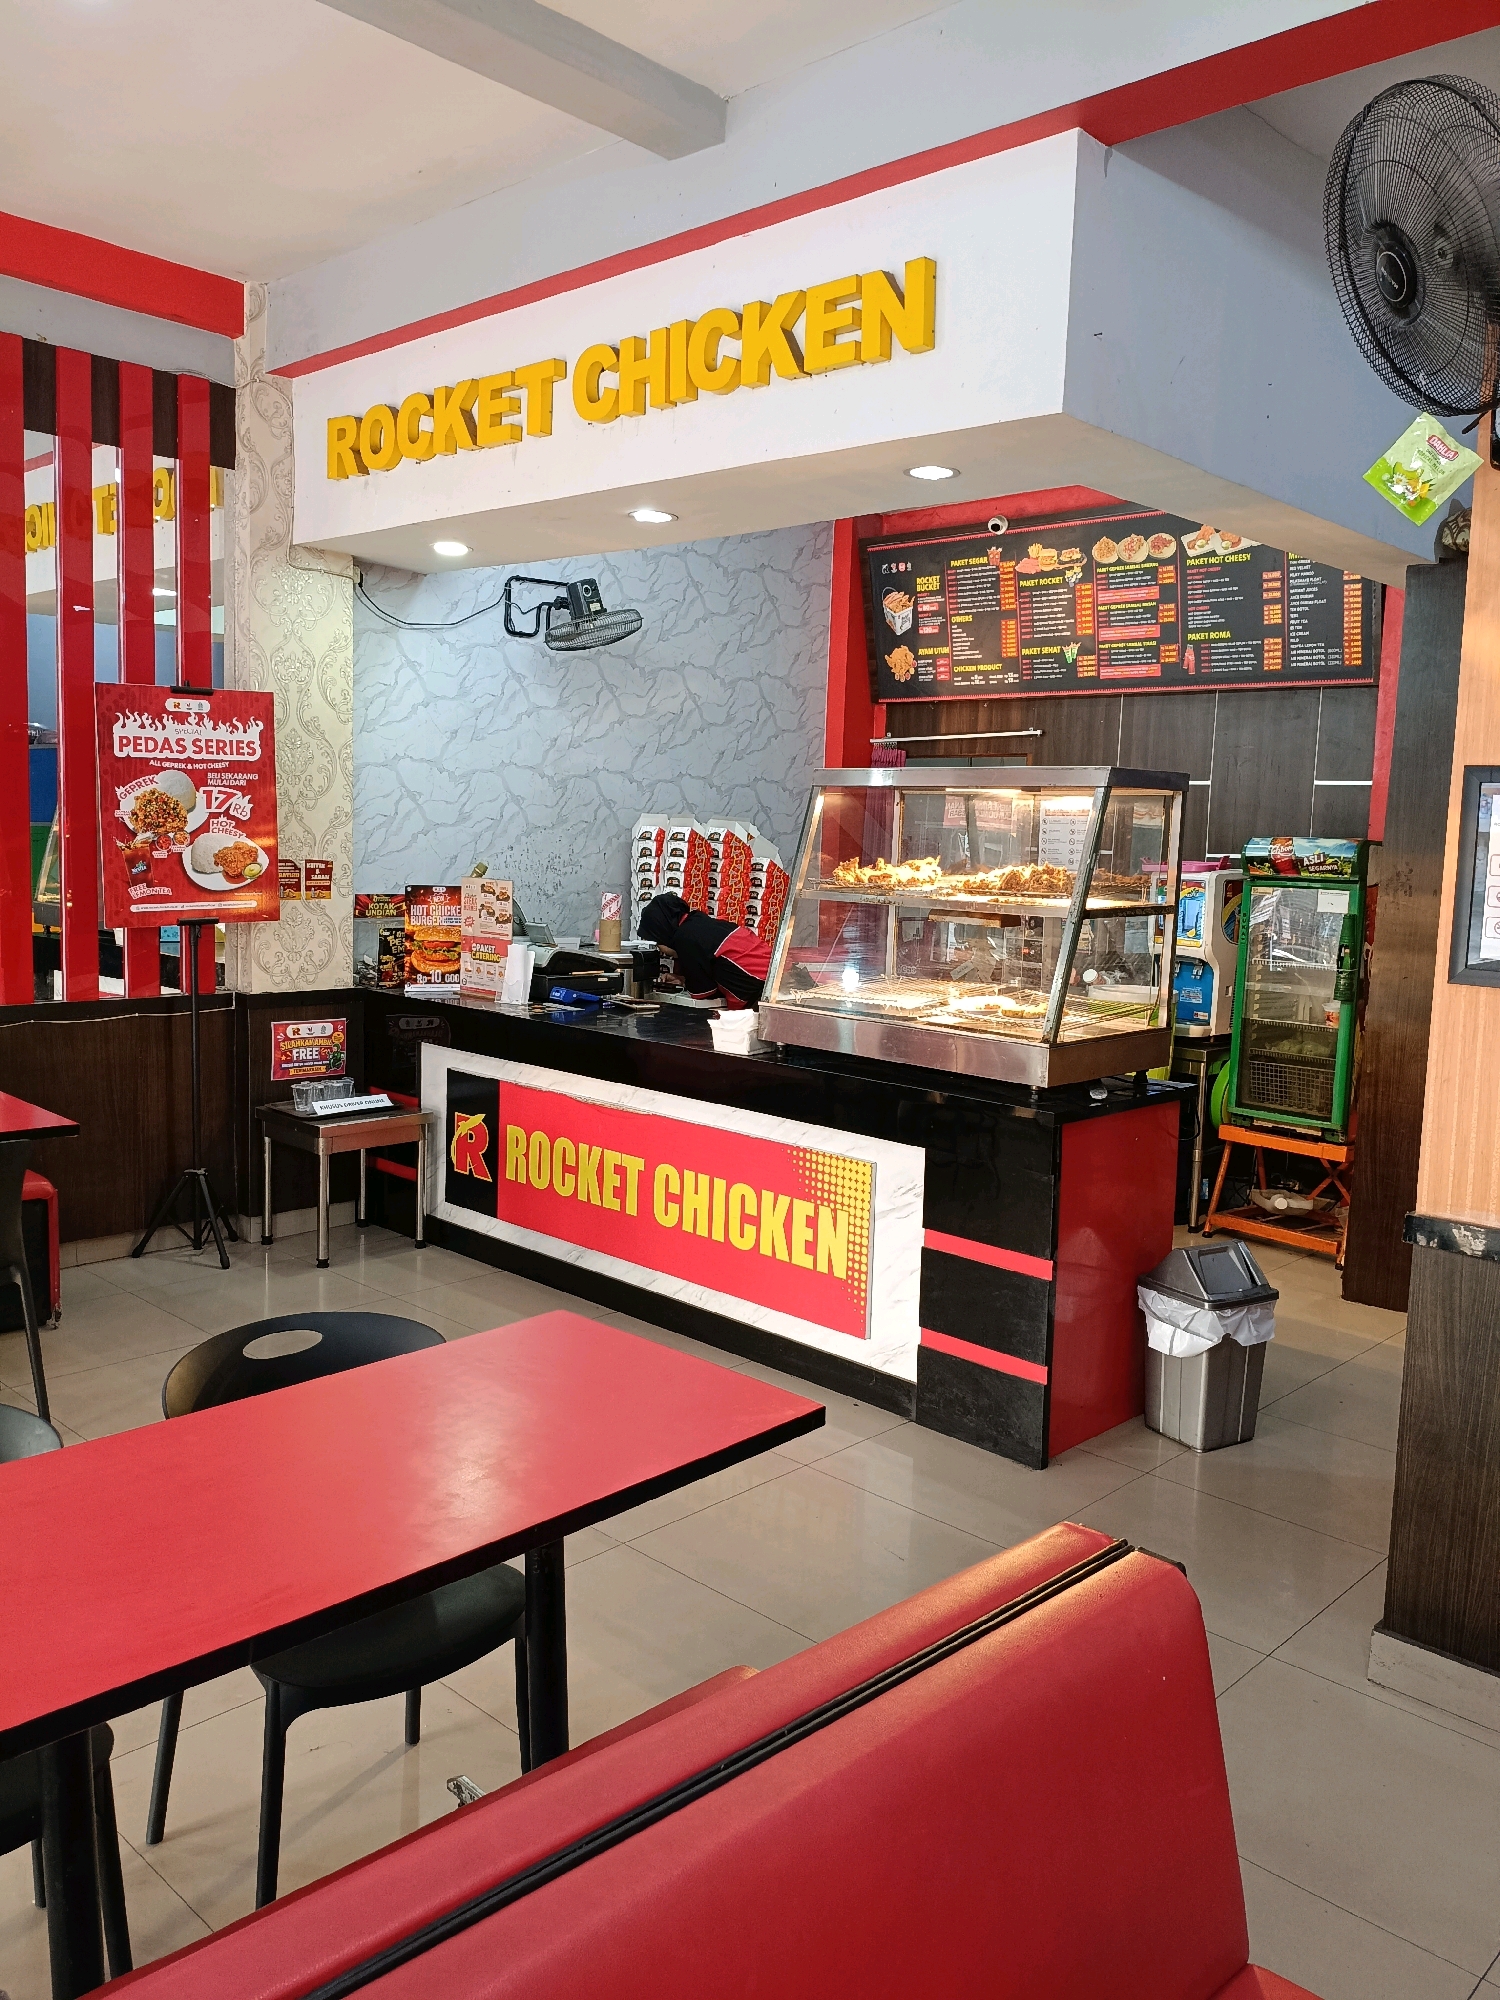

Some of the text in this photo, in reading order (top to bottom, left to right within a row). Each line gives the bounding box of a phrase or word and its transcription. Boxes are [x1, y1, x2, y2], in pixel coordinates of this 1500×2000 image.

[327, 256, 936, 481] ROCKET CHICKEN
[1429, 436, 1456, 460] DAHLIA
[951, 558, 968, 567] PAKET
[1187, 553, 1251, 566] PAKET HOT CHEESY
[917, 576, 940, 585] ROCKET
[1020, 577, 1063, 587] PAKET ROCKET
[917, 582, 940, 592] BUCKET
[952, 615, 973, 623] OTHERS
[1210, 631, 1231, 639] ROMA
[918, 648, 934, 656] AYAM
[1022, 646, 1061, 656] PAKET SEHAT
[954, 663, 1003, 673] CHICKEN PRODUCT
[119, 735, 257, 757] PEDAS SERIES
[162, 761, 186, 769] GEPREK
[207, 762, 230, 770] CHEESY
[223, 772, 259, 780] SEKARANG
[119, 776, 160, 800] GEPREK
[202, 789, 248, 817] 17 Rb
[211, 819, 235, 828] HOT
[211, 827, 243, 839] CHEESY
[1304, 853, 1325, 867] ASLI
[1308, 864, 1338, 872] SEGARNYA
[130, 883, 147, 895] FREE
[410, 905, 461, 917] HOT CHICKE
[411, 916, 443, 926] BURGER
[477, 943, 496, 951] PAKET
[471, 952, 501, 962] CATERING
[417, 974, 428, 984] Rp
[293, 1048, 320, 1061] FREE
[506, 1124, 850, 1281] ROCKET CHICKEN
